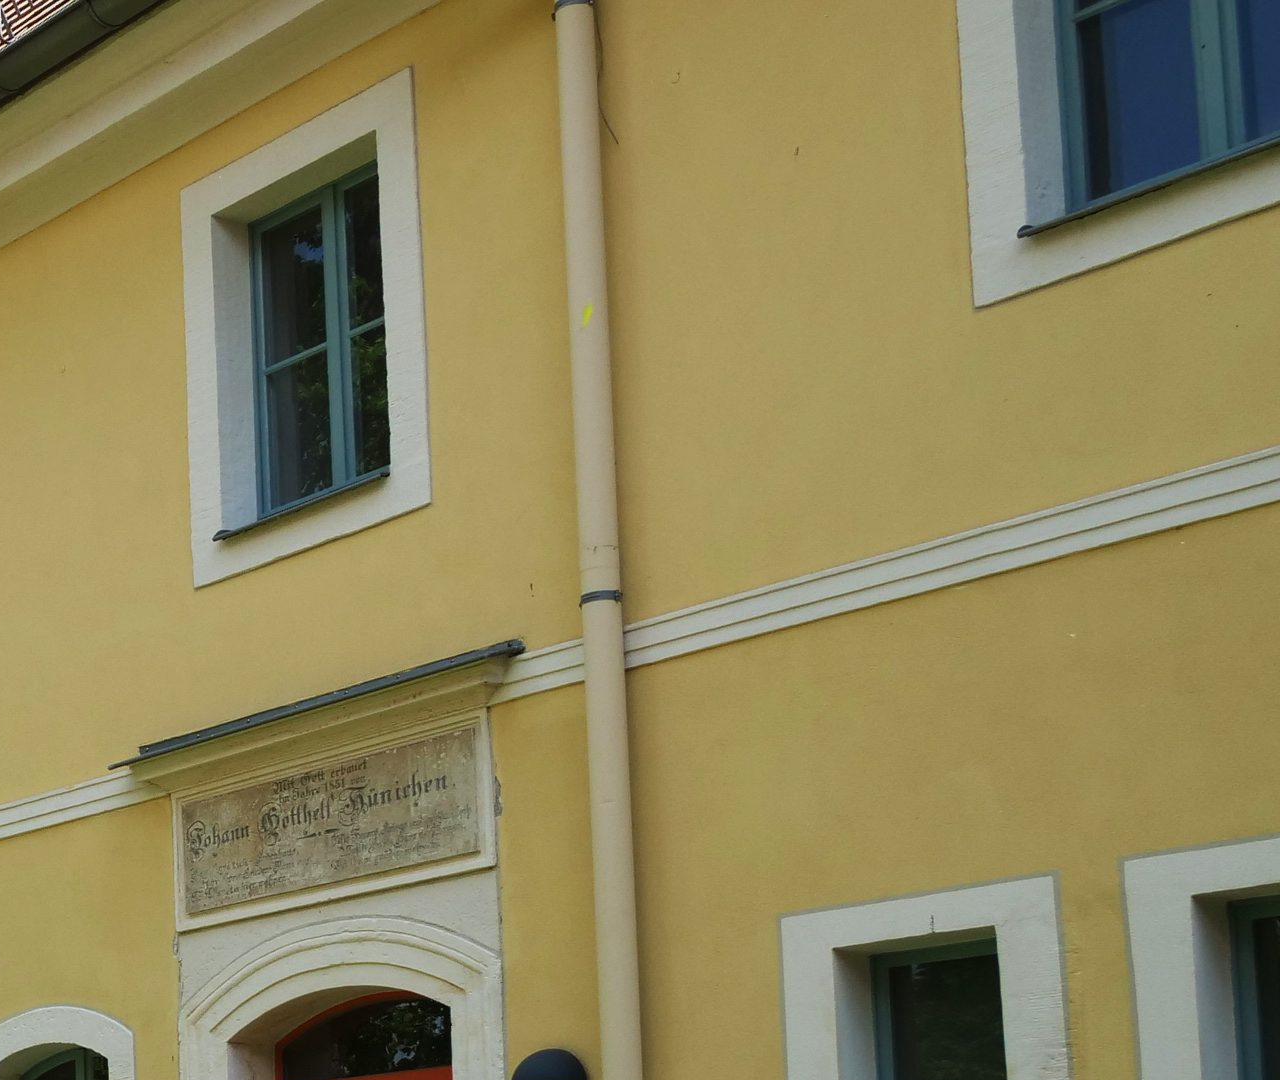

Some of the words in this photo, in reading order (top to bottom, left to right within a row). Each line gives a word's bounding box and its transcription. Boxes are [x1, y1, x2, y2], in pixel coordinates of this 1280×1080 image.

[271, 778, 295, 794] Mit
[300, 770, 325, 786] Gott
[322, 777, 345, 792] 1851
[186, 820, 250, 862] Johann
[257, 793, 334, 846] Gotthelf
